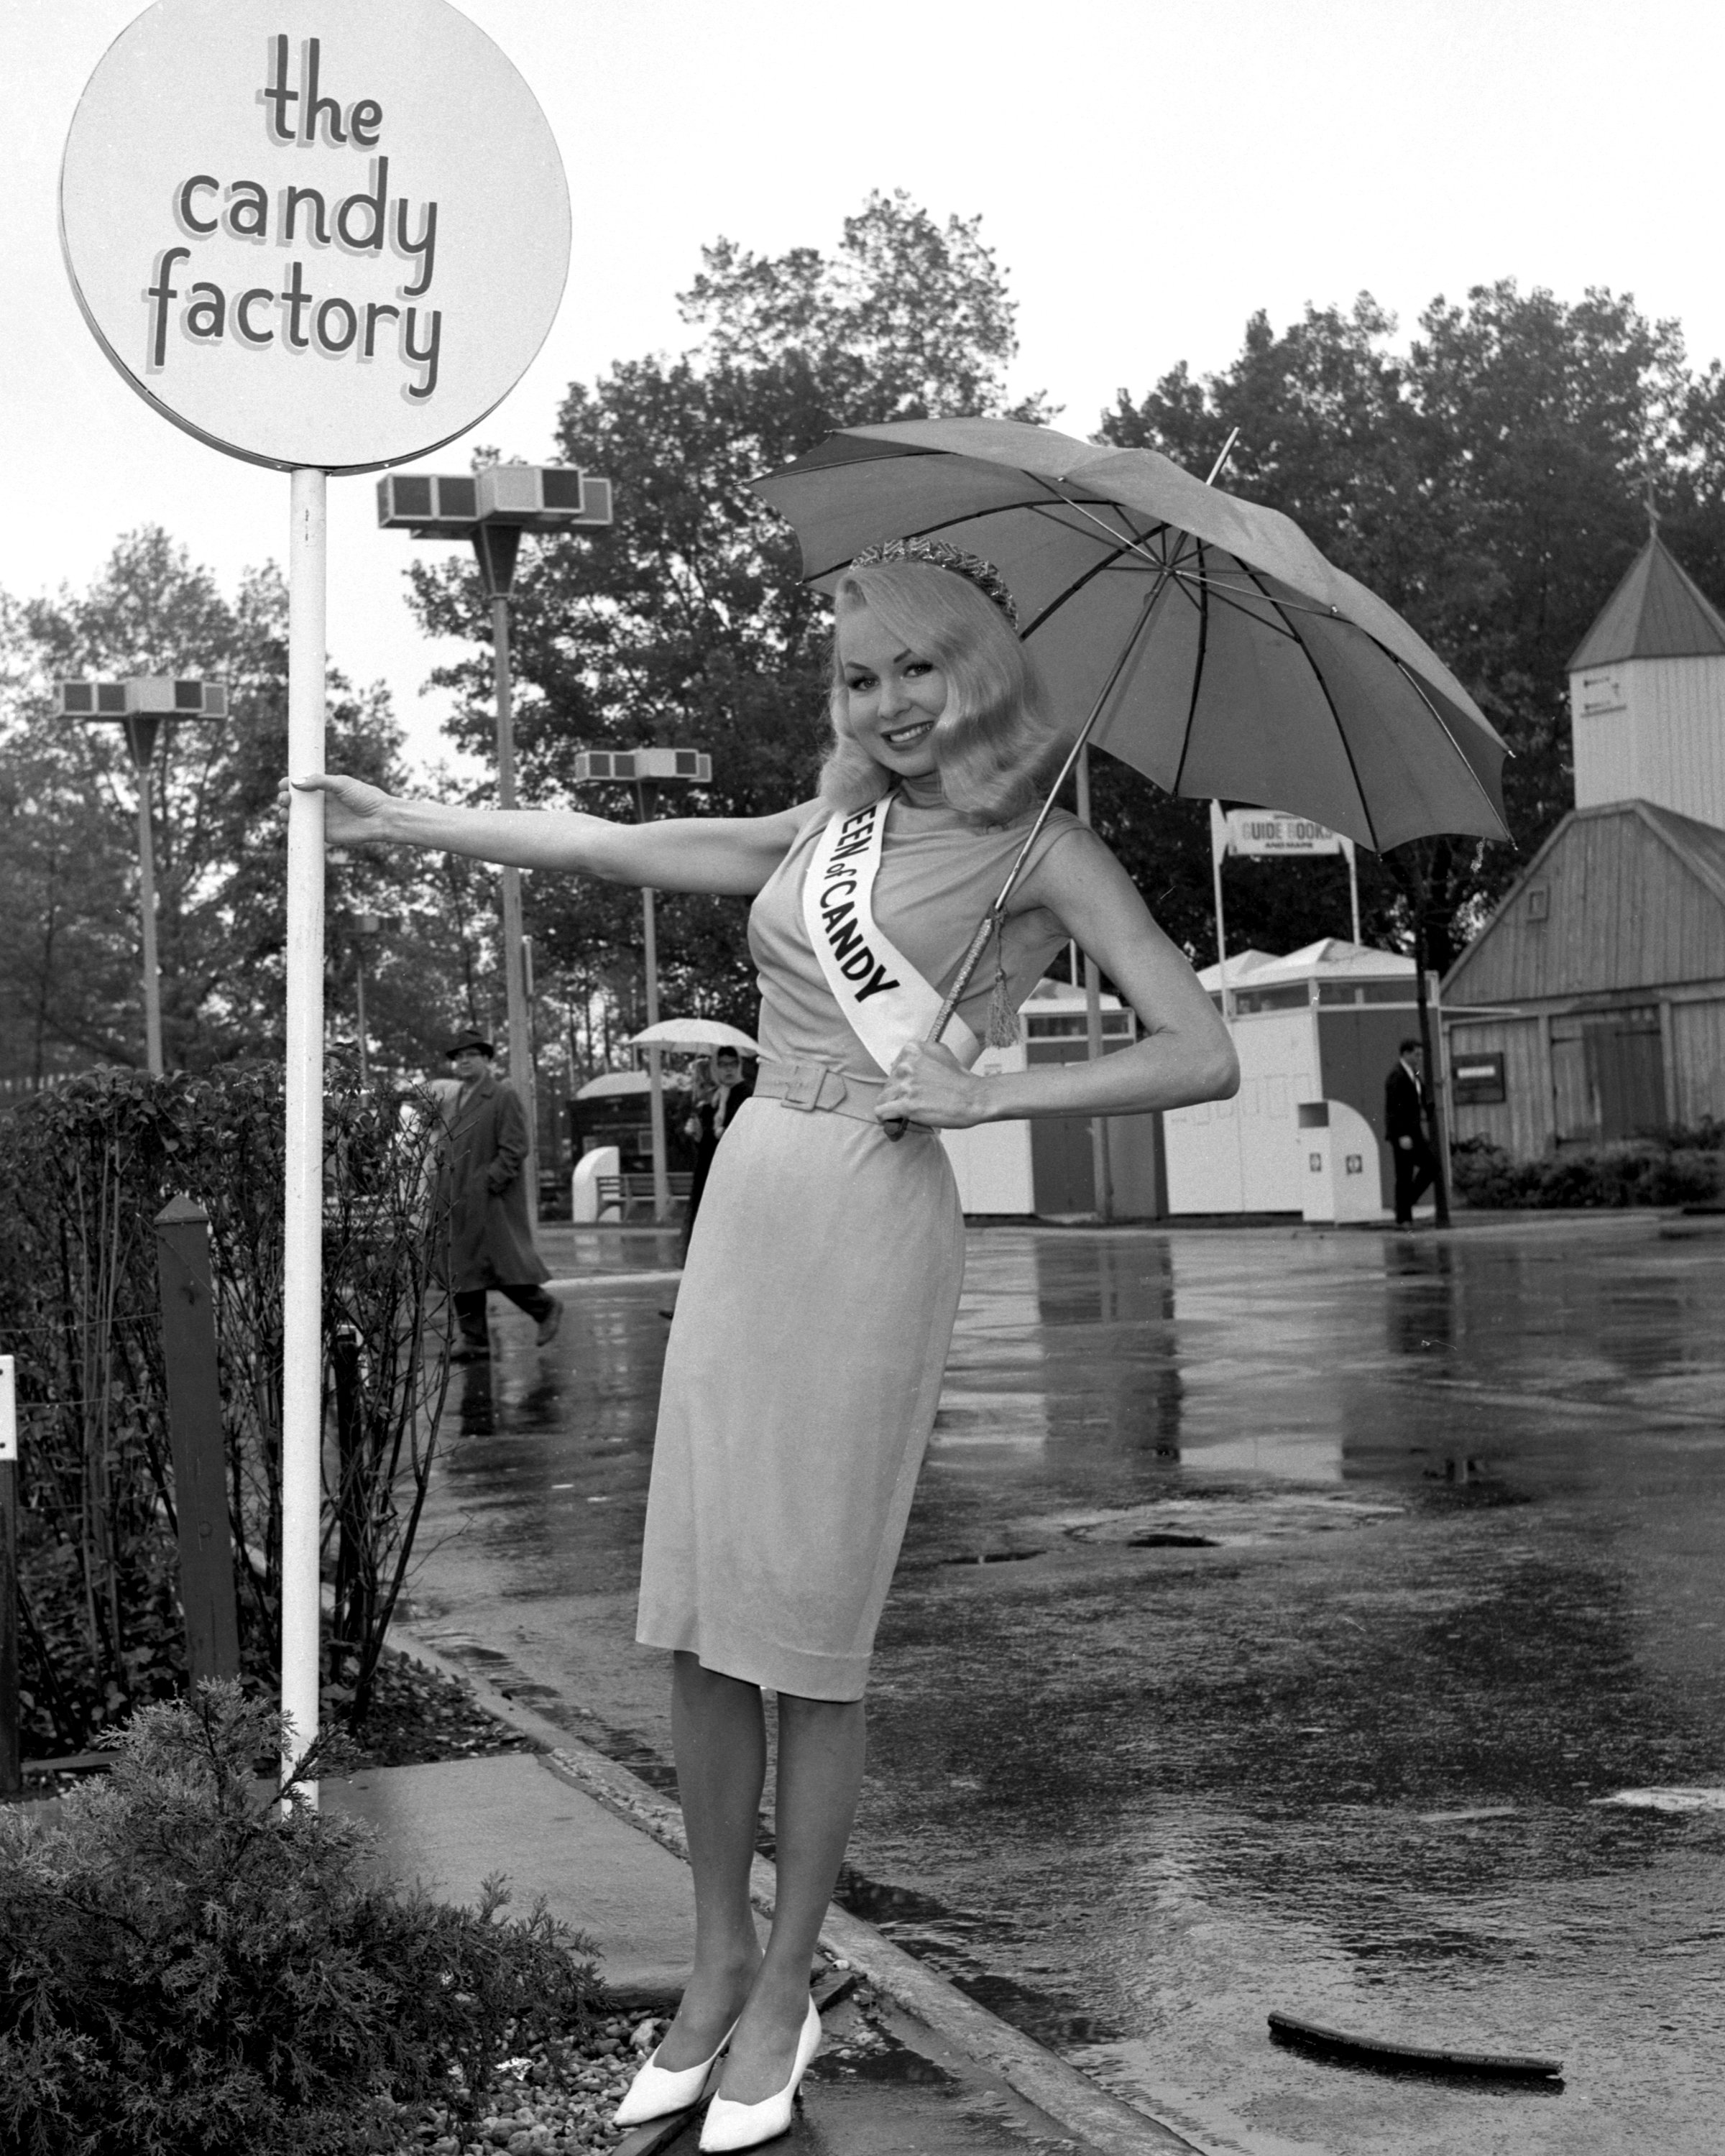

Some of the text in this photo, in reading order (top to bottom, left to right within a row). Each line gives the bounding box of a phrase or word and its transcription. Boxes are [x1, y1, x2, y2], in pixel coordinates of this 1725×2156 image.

[264, 34, 384, 146] the
[180, 155, 438, 297] candy
[148, 247, 442, 399] factory
[824, 862, 857, 880] of
[1242, 821, 1282, 840] GUIDE
[819, 880, 901, 1003] CANDY
